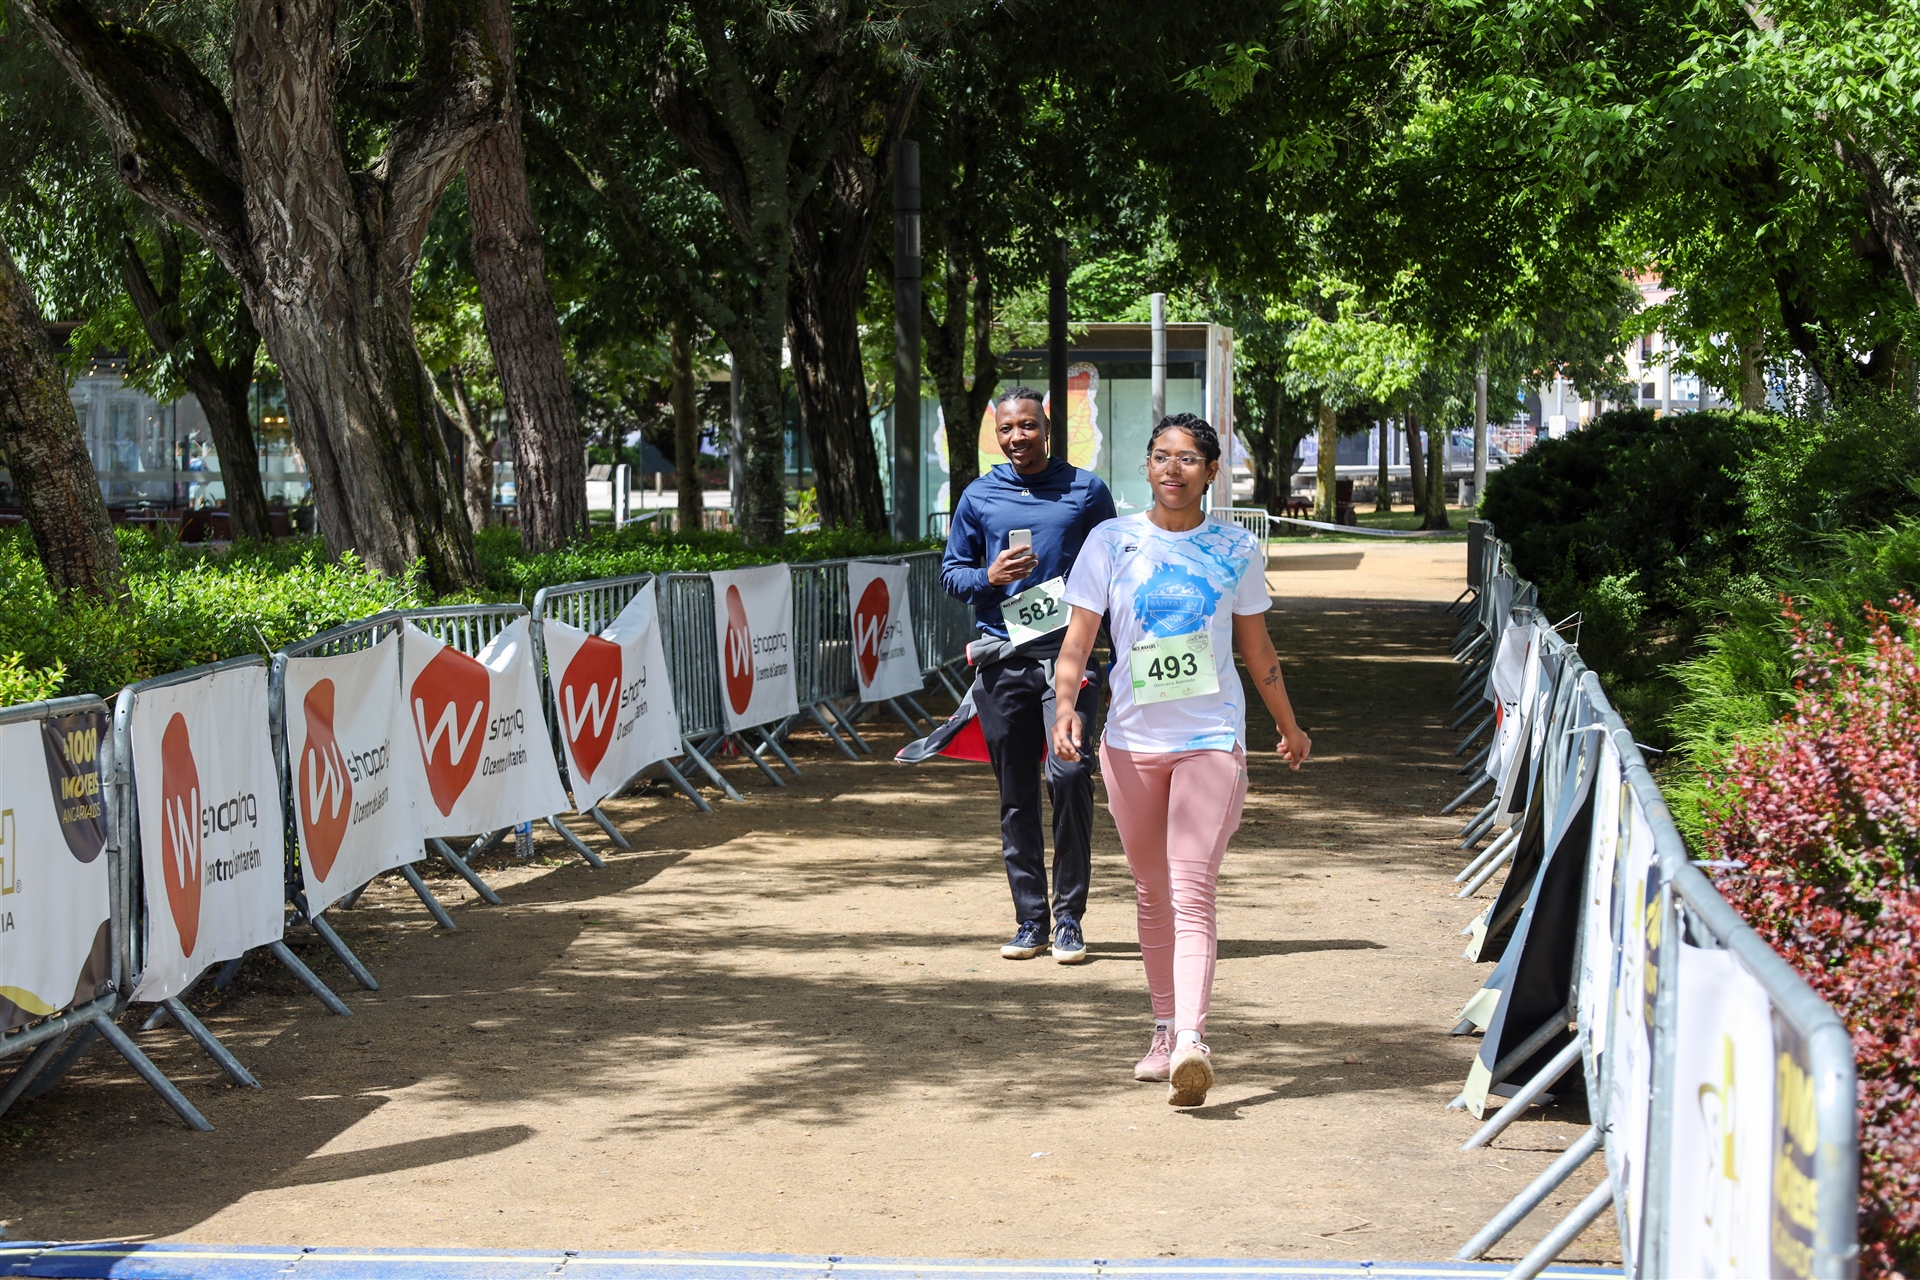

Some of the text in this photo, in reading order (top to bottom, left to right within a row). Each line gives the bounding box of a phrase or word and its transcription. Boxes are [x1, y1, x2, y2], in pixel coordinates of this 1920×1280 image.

[857, 612, 888, 657] W
[1018, 597, 1059, 626] 582
[729, 625, 750, 679] W
[1147, 652, 1198, 681] 493
[414, 697, 484, 767] W
[564, 676, 619, 744] W
[308, 738, 390, 826] W shoppg
[165, 786, 258, 890] W shoping
[233, 840, 262, 877] antarém
